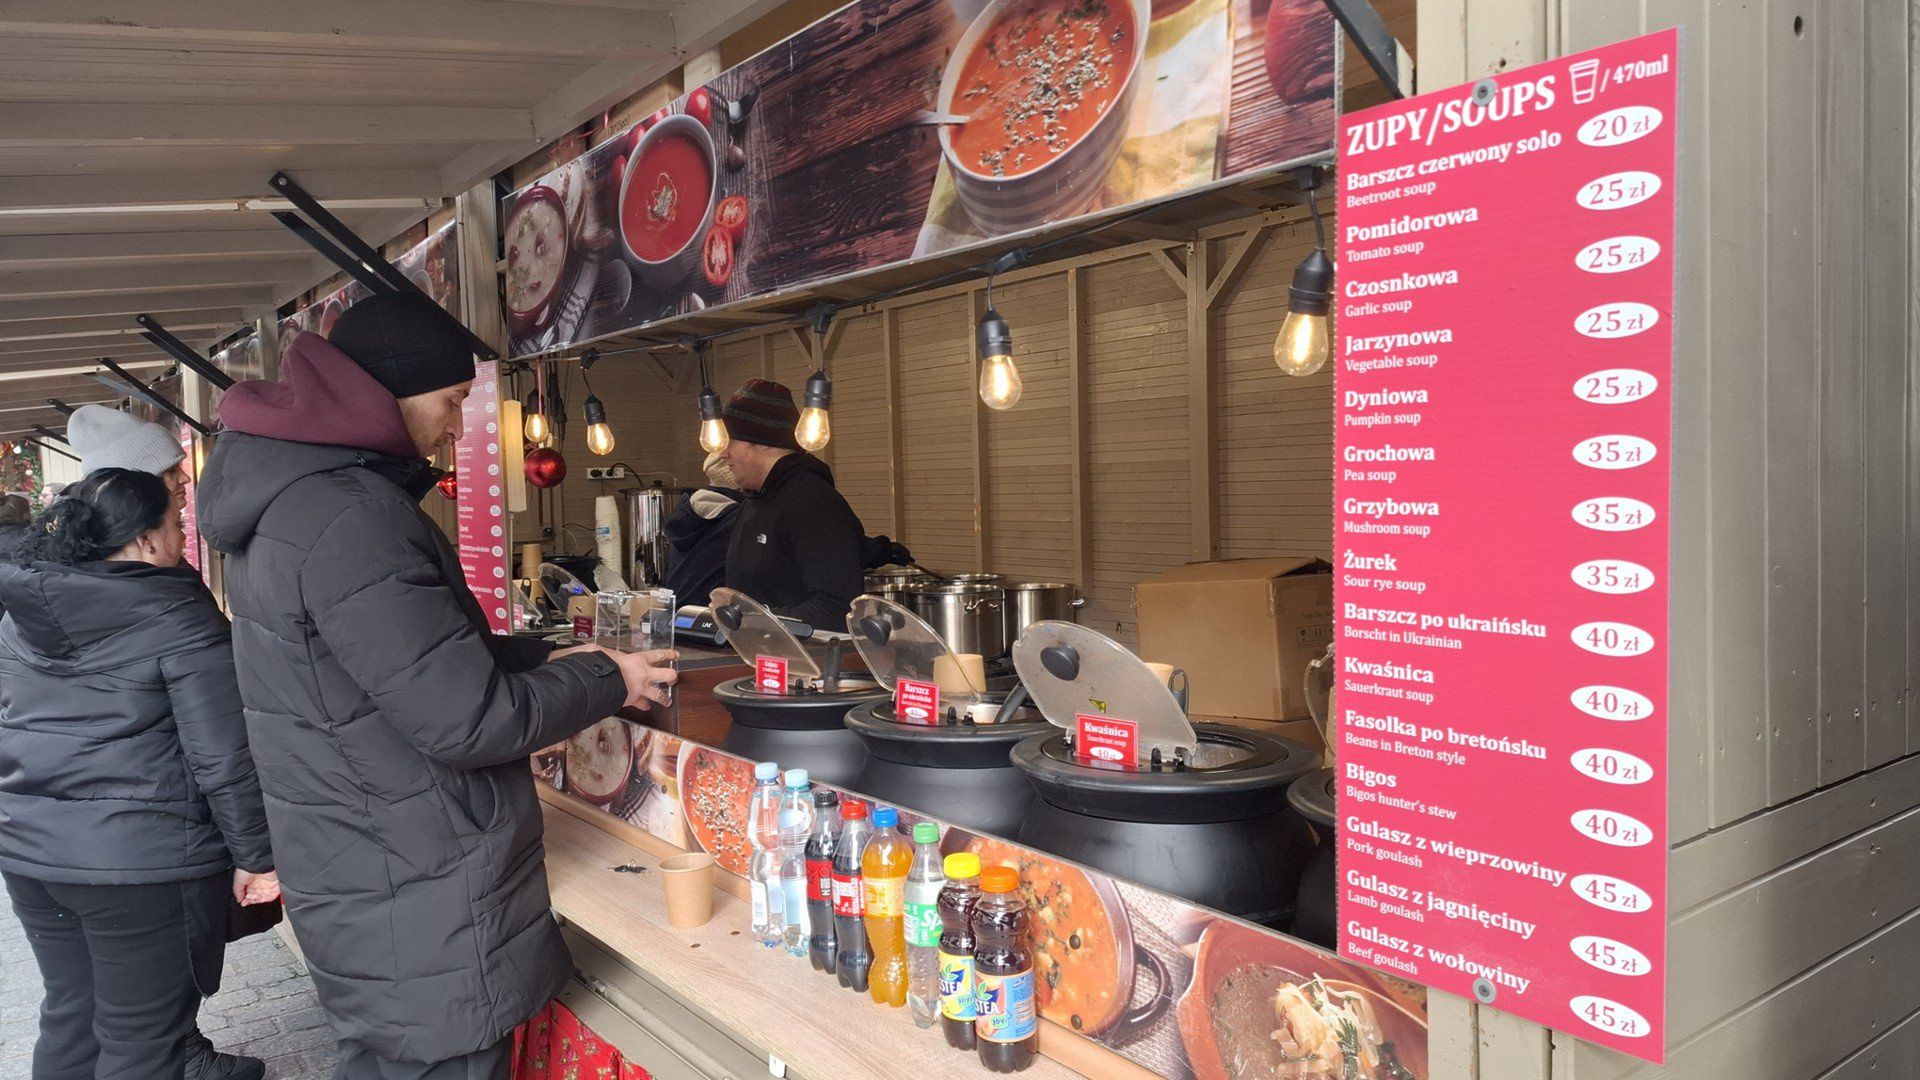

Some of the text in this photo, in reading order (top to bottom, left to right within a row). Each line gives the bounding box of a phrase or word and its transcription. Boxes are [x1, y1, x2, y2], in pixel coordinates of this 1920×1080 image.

[1347, 130, 1561, 190] Barszcz czerwony solo
[1347, 182, 1436, 208] Beetroot soup
[1347, 208, 1478, 243] Pomidorowa
[1346, 242, 1424, 262] Tomato soup
[1345, 270, 1458, 297] Czosnkowa
[1345, 301, 1412, 317] Garlic soup
[1345, 329, 1452, 356] Jarzynowa
[1345, 355, 1437, 373] Vegetable soup
[1345, 388, 1428, 411] Dyniowa
[1345, 413, 1421, 428] Pumpkin soup
[1344, 444, 1435, 462] Grochowa
[1344, 469, 1396, 483] Pea soup
[1344, 498, 1439, 519] Grzybowa
[1344, 521, 1430, 538] Mushroom soup
[1344, 549, 1397, 571] Żurek
[1344, 575, 1426, 594] Sour rye soup
[1344, 602, 1417, 625] Barszcz
[1421, 614, 1444, 630] po
[1448, 614, 1546, 637] ukraińsku
[1344, 626, 1462, 649] Borscht in Ukrainian
[1345, 657, 1434, 683] Kwaśnica
[1345, 679, 1433, 705] Sauerkraut soup
[1084, 722, 1129, 738] Kwaśnica
[1345, 710, 1546, 759] Fasolka po bretońsku
[1346, 732, 1465, 765] Beans in Breton style
[1346, 763, 1396, 789] Bigos
[1346, 785, 1376, 802] Bigos
[1428, 806, 1456, 819] stew
[1346, 816, 1567, 887] Gulasz z wieprzowiny
[1347, 838, 1422, 868] Pork goulash
[1347, 870, 1536, 939] Gulasz z jagnięciny
[1348, 890, 1424, 922] Lamb goulash
[1348, 921, 1530, 994] Gulasz z wołowiny
[1349, 942, 1417, 974] Beef goulash
